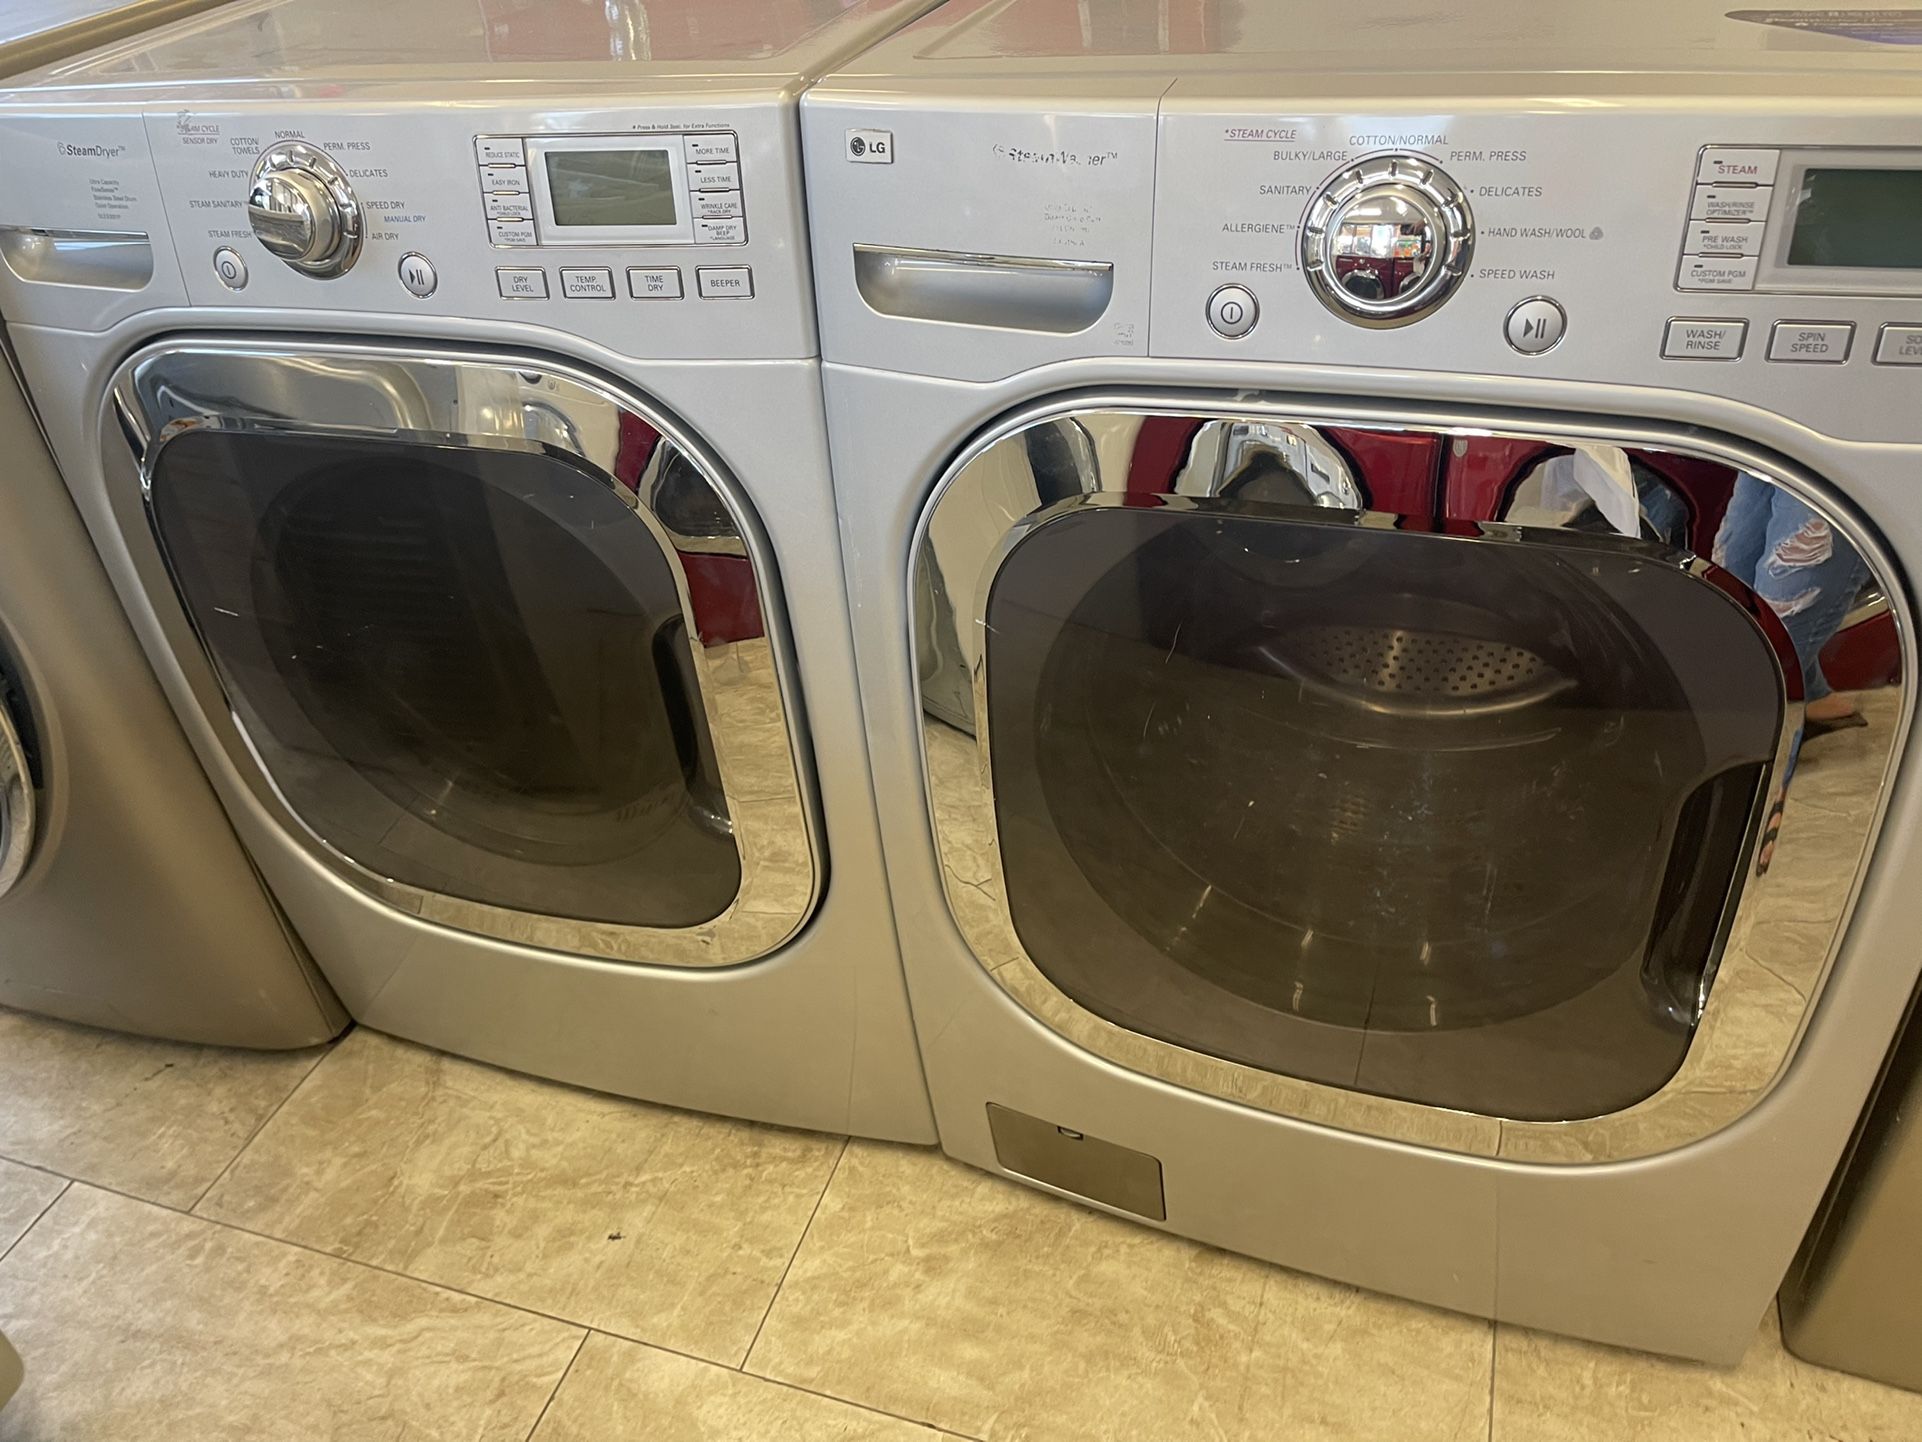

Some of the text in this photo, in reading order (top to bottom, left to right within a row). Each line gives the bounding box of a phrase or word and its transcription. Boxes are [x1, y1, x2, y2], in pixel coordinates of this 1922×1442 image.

[275, 130, 305, 139] NORMAL
[1265, 129, 1296, 139] CYCLE
[1349, 135, 1449, 146] COTTON/NORMAL
[232, 146, 260, 155] TOWELS
[323, 142, 371, 150] PERM. PRESS
[869, 141, 886, 153] LG
[1273, 151, 1347, 161] BULKY/LARGE
[1450, 151, 1527, 161] PERM. PRESS
[208, 170, 249, 178] HEAVY DUTY
[350, 169, 388, 178] DELICATES
[1717, 165, 1758, 175] STEAM
[700, 176, 716, 184] LESS
[1259, 185, 1312, 195] SANITARY
[1479, 186, 1543, 197] DELICATES
[189, 200, 211, 208] STEAM
[367, 201, 405, 210] SPEED DRY
[1707, 201, 1755, 209] WASH/RINSE
[384, 215, 426, 223] MANUAL DRY
[1222, 223, 1296, 234] ALLERGIENE™
[1487, 227, 1586, 239] HAND WASH/WOOL
[208, 230, 230, 238] STEAM
[371, 232, 399, 240] AIR DRY
[1702, 235, 1748, 244] PRE WASH
[1212, 261, 1293, 272] STEAM FRESH™
[1479, 269, 1555, 280] SPEED WASH
[1727, 270, 1746, 278] PGM
[513, 276, 528, 284] DRY
[575, 276, 597, 284] TEMP.
[644, 275, 664, 283] TIME
[710, 279, 740, 288] BEEPER
[512, 284, 534, 292] LEVEL
[570, 284, 606, 293] CONTROL
[648, 283, 664, 292] DRY
[1685, 329, 1726, 340] WASH/
[1798, 332, 1826, 342] SPIN
[1685, 340, 1721, 350] RINSE
[1790, 343, 1829, 353] SPEED
[1899, 345, 1922, 355] LEV
